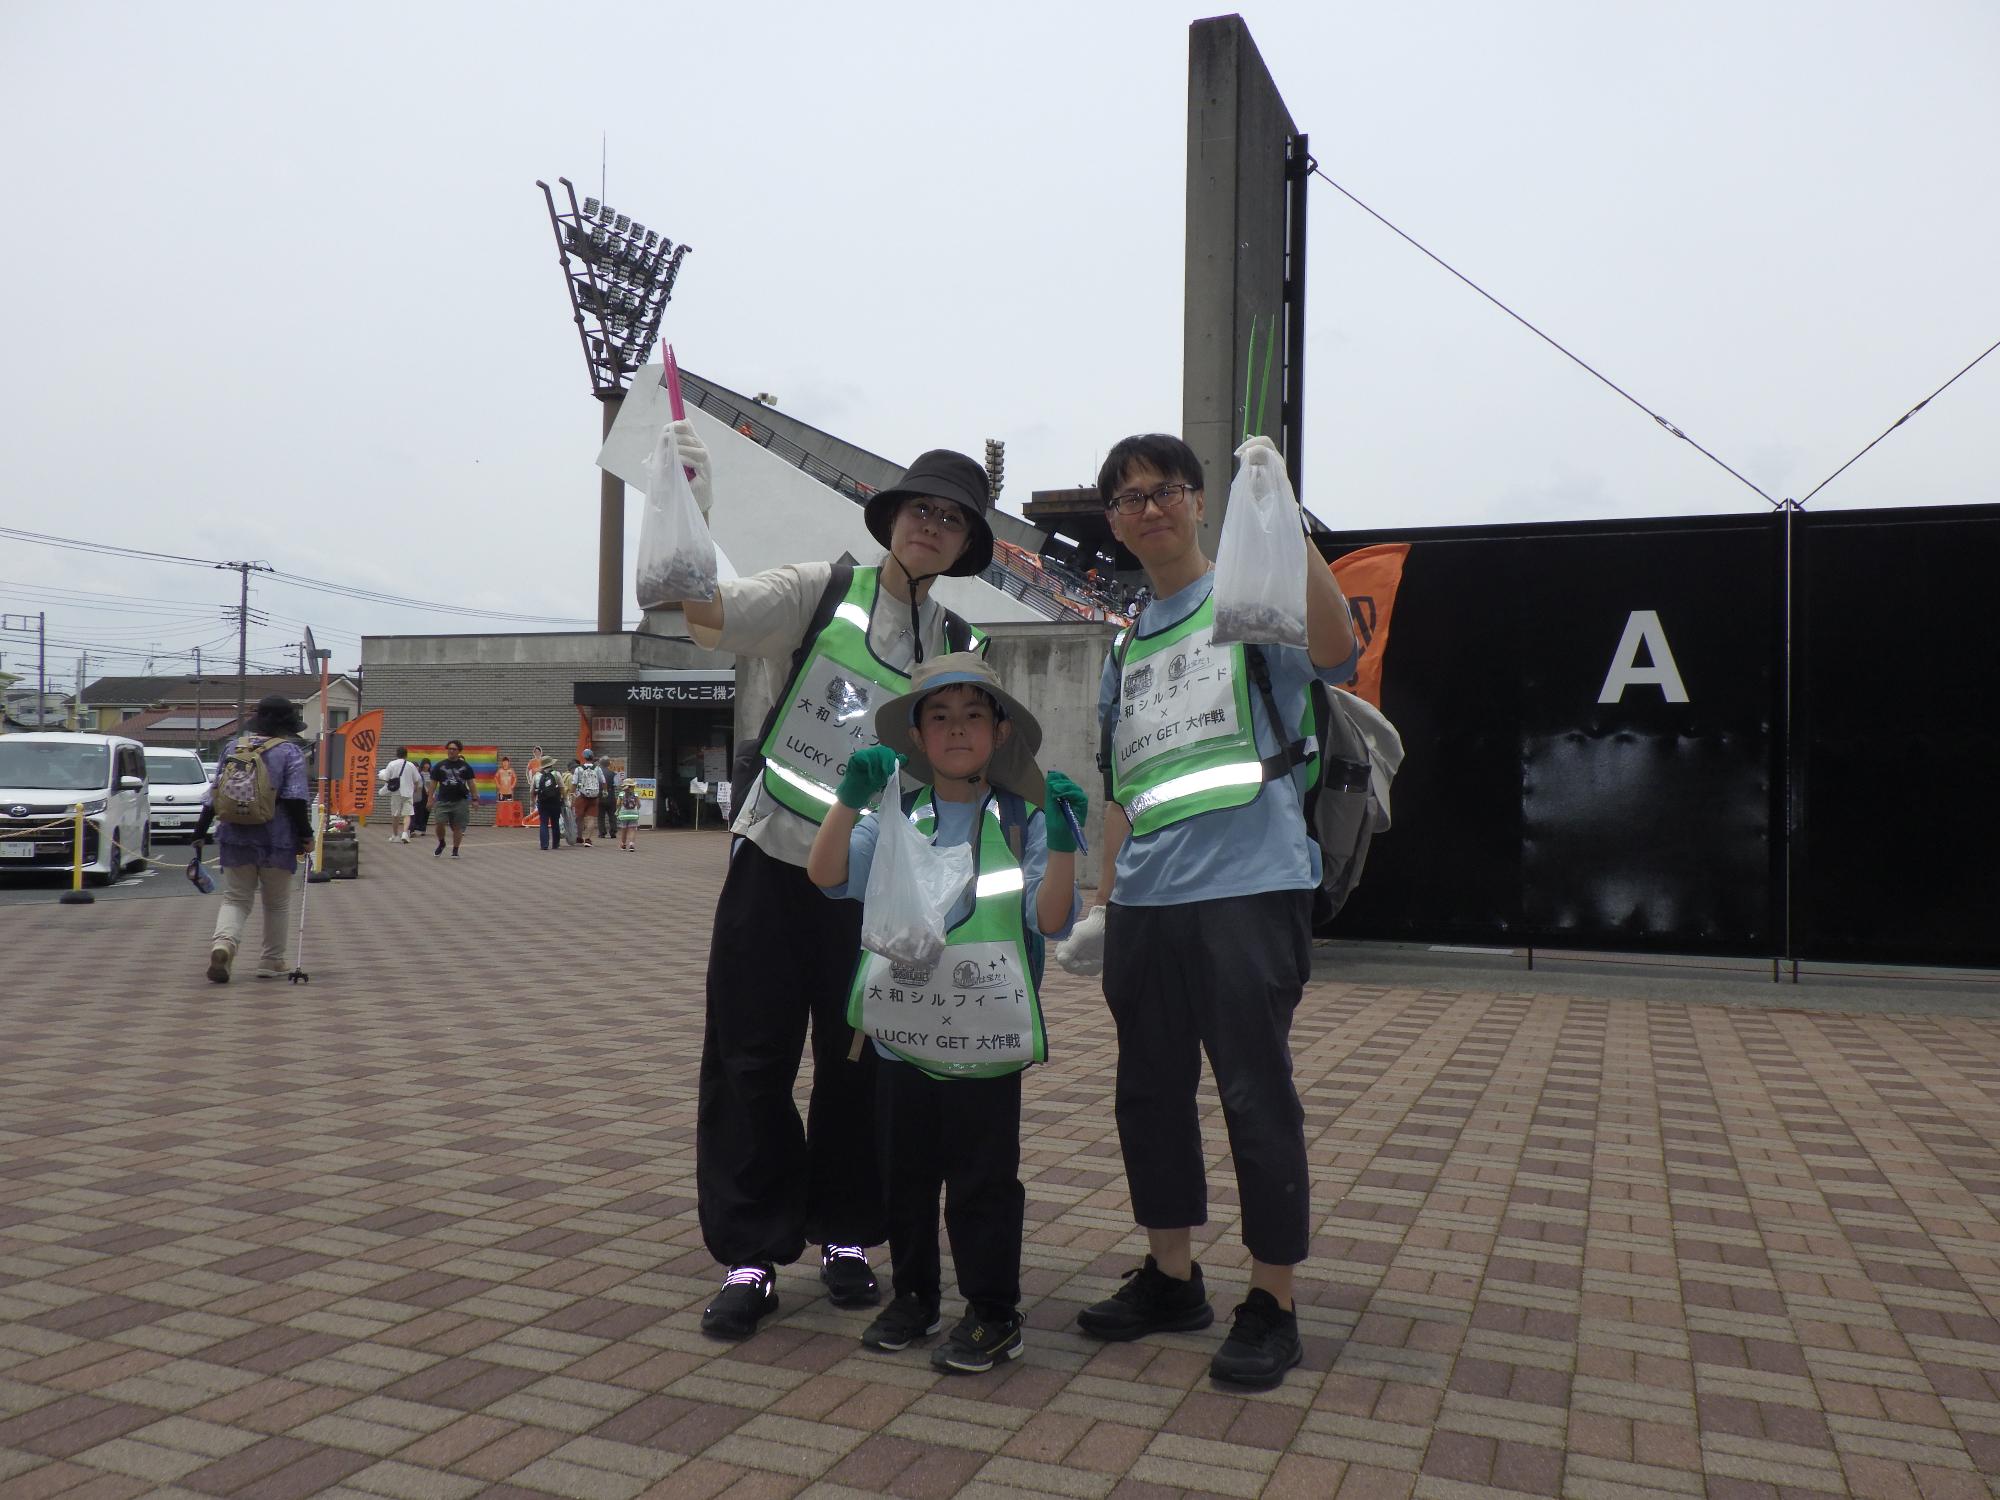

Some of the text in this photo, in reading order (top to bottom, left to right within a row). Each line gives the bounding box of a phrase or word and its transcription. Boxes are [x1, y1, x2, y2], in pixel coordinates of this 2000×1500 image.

[1597, 610, 1690, 704] A
[1119, 668, 1227, 723] 和シルフィード
[786, 736, 833, 767] LUCKY
[1121, 709, 1225, 761] LUCKY GET 大作戦
[869, 985, 1024, 1008] 大和シルフィード
[875, 1028, 1021, 1050] LUCKY GET 大作戦
